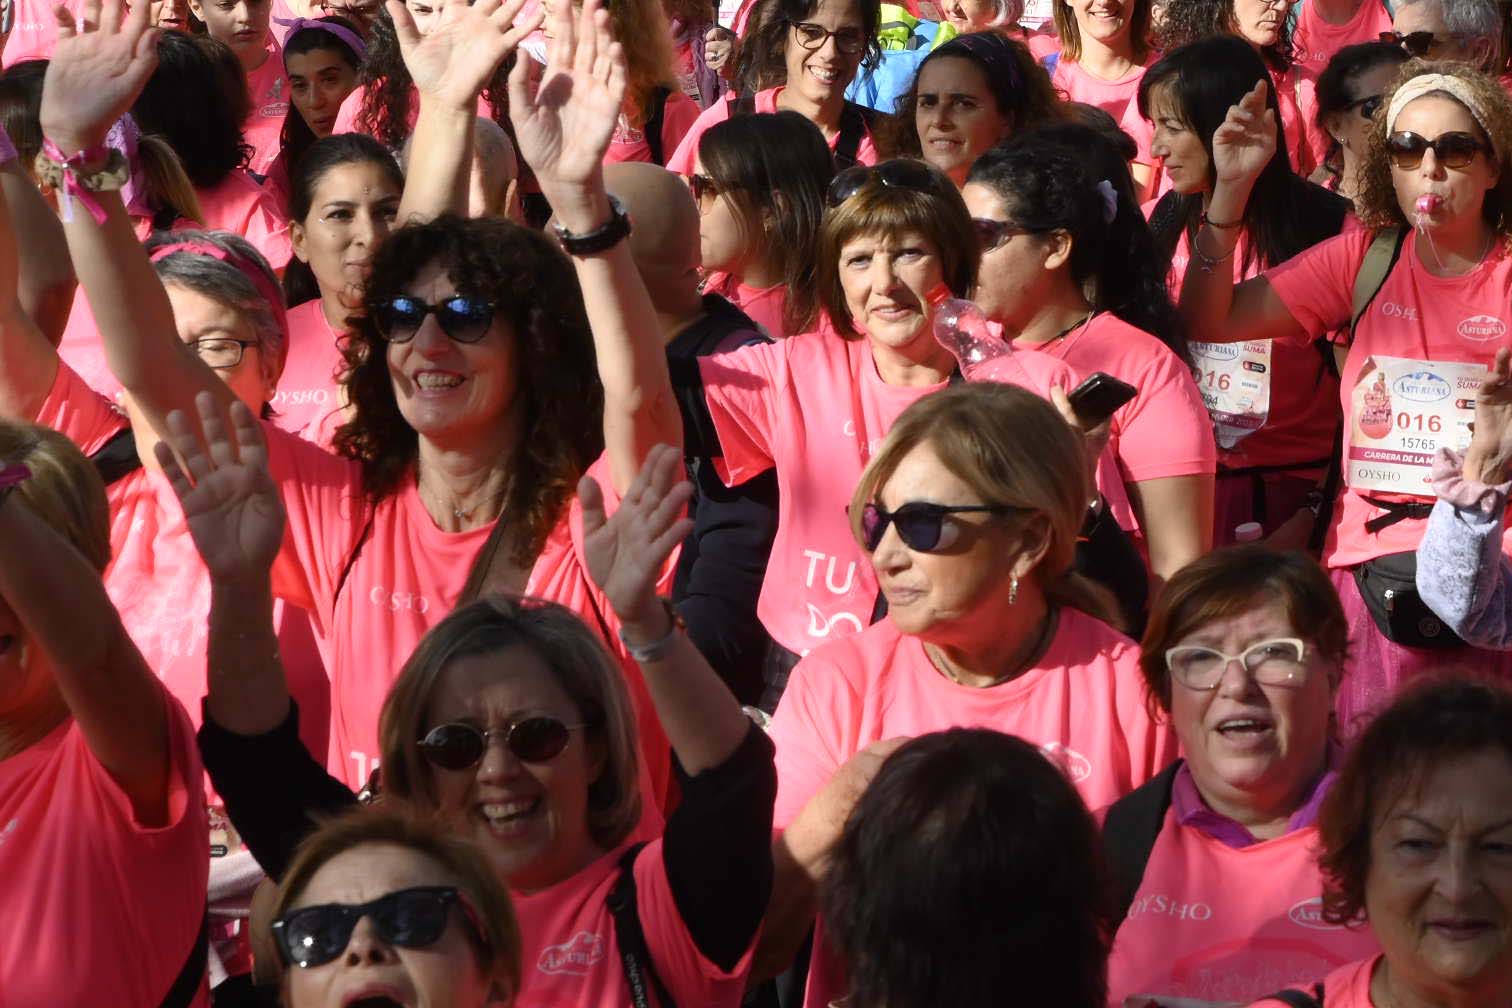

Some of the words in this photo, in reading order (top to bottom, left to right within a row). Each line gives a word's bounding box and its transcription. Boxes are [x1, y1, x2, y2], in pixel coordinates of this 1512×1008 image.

[1397, 411, 1442, 432] 016
[1401, 437, 1435, 450] 15765
[1364, 451, 1401, 462] CARRERA
[1402, 455, 1414, 463] DE
[1414, 456, 1425, 464] LA
[1358, 468, 1401, 481] OYSHO
[805, 549, 856, 594] TU
